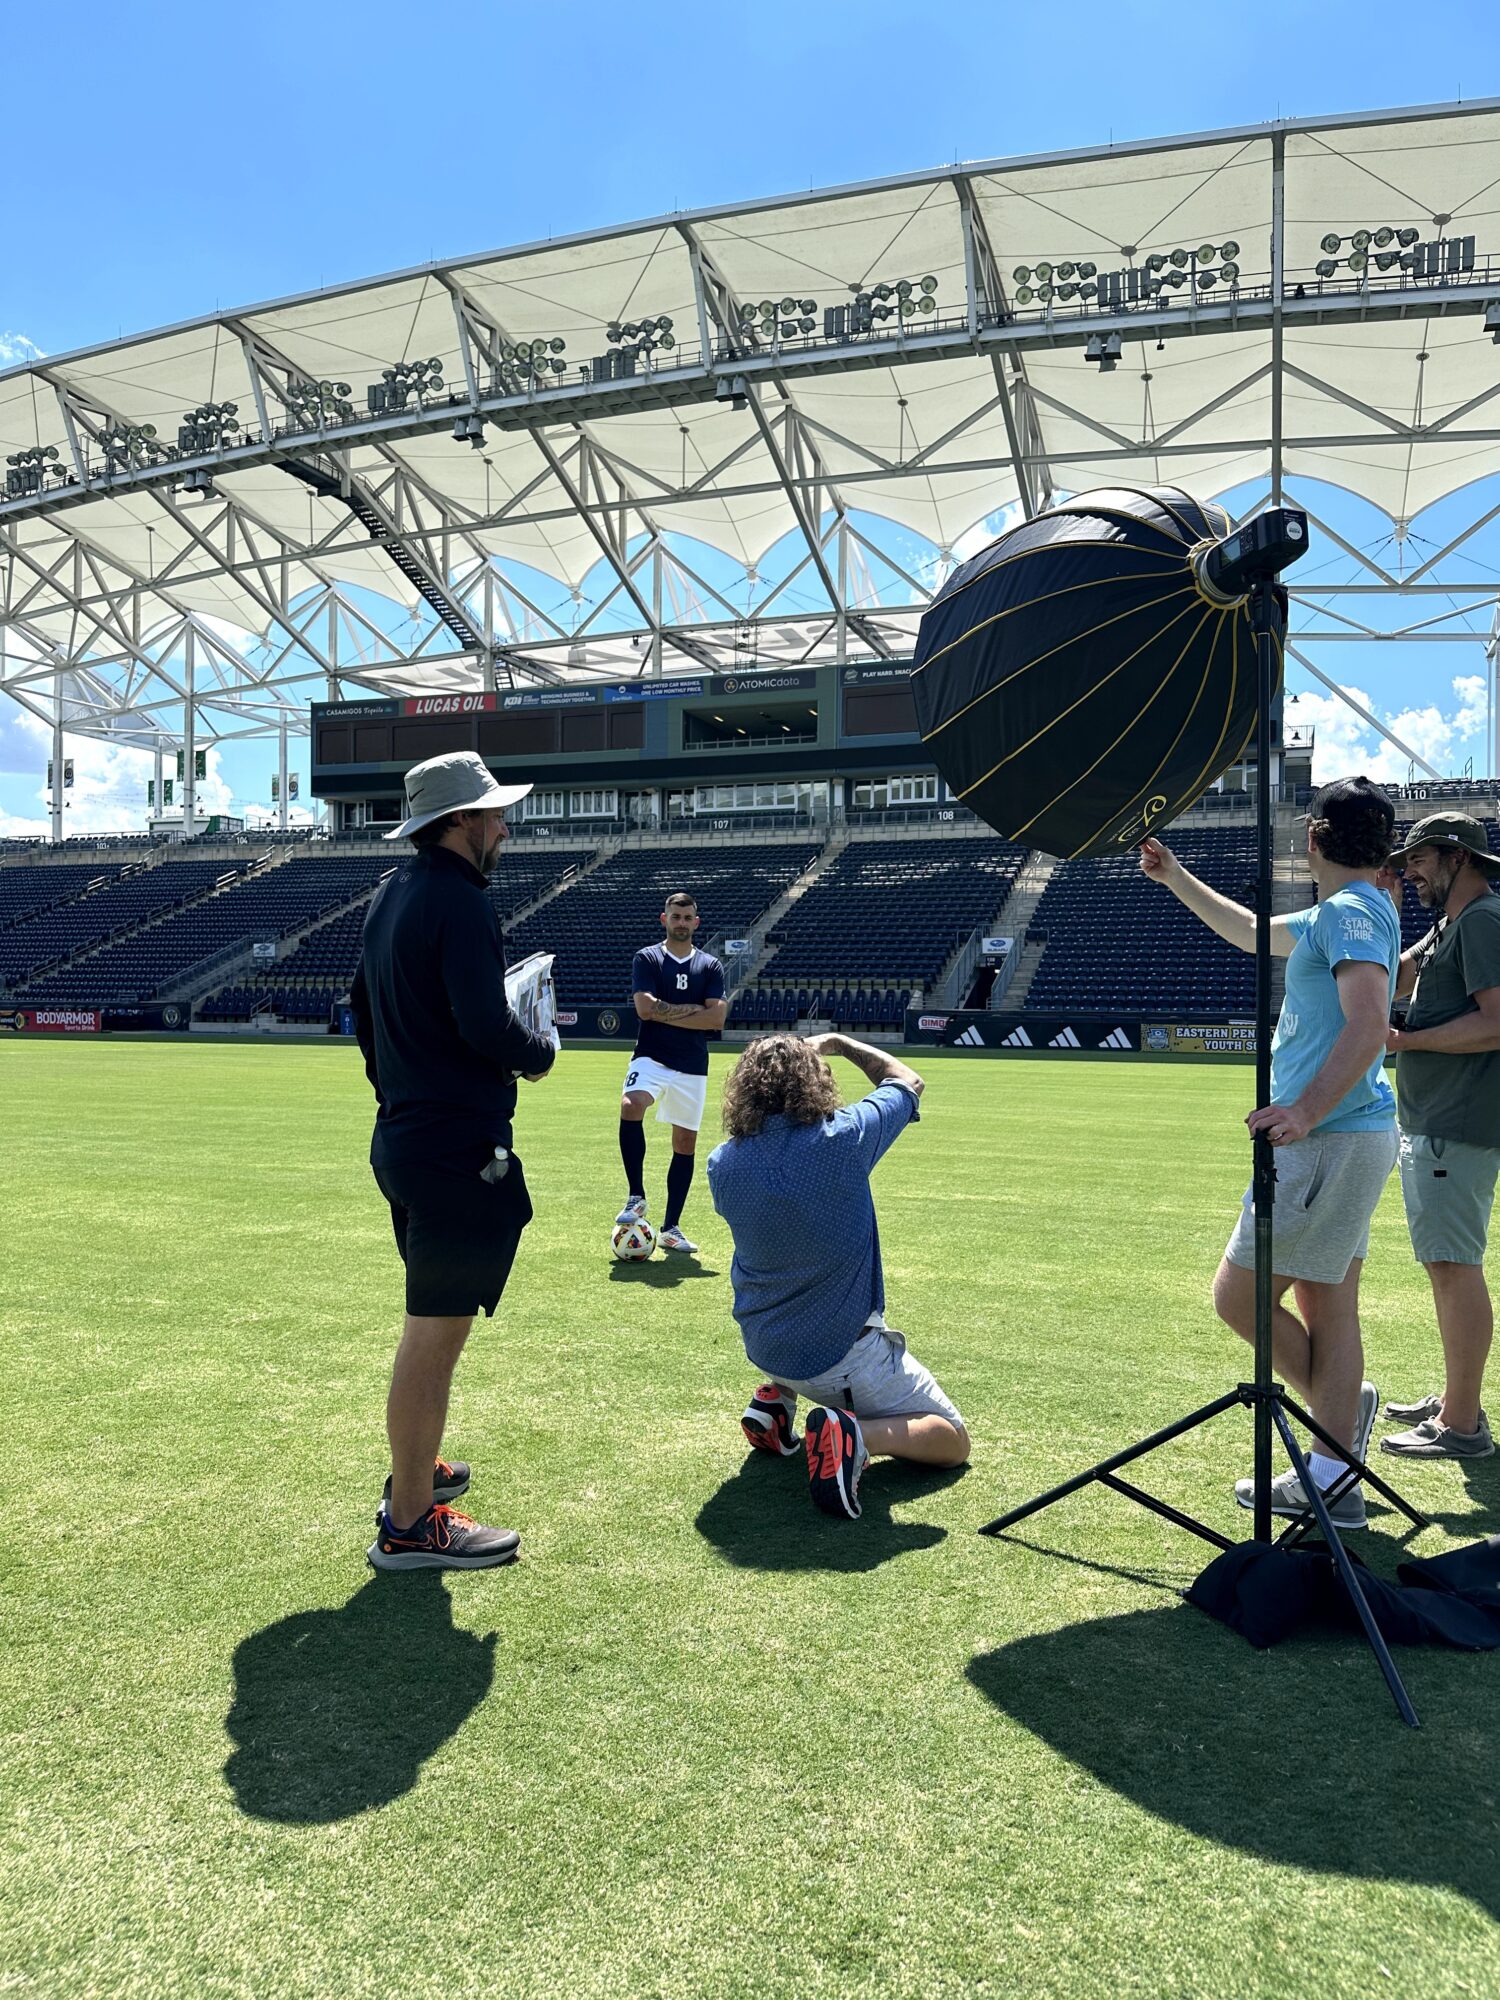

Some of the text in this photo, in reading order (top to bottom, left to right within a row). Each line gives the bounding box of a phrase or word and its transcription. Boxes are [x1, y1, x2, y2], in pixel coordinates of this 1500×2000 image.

[739, 677, 800, 690] ATOMICdata
[415, 695, 485, 714] LUCAS OIL
[326, 707, 362, 716] CASAMIGOS
[1407, 789, 1427, 800] 110
[938, 810, 954, 820] 108
[713, 820, 729, 829] 107
[536, 827, 550, 836] 106
[236, 836, 248, 845] 104
[1345, 919, 1374, 930] STARS
[1348, 929, 1375, 941] TRIBE
[676, 973, 688, 990] 18
[36, 1012, 95, 1025] BODYARMOR
[1175, 1027, 1257, 1039] EASTERN PEN
[1203, 1040, 1242, 1050] YOUTH
